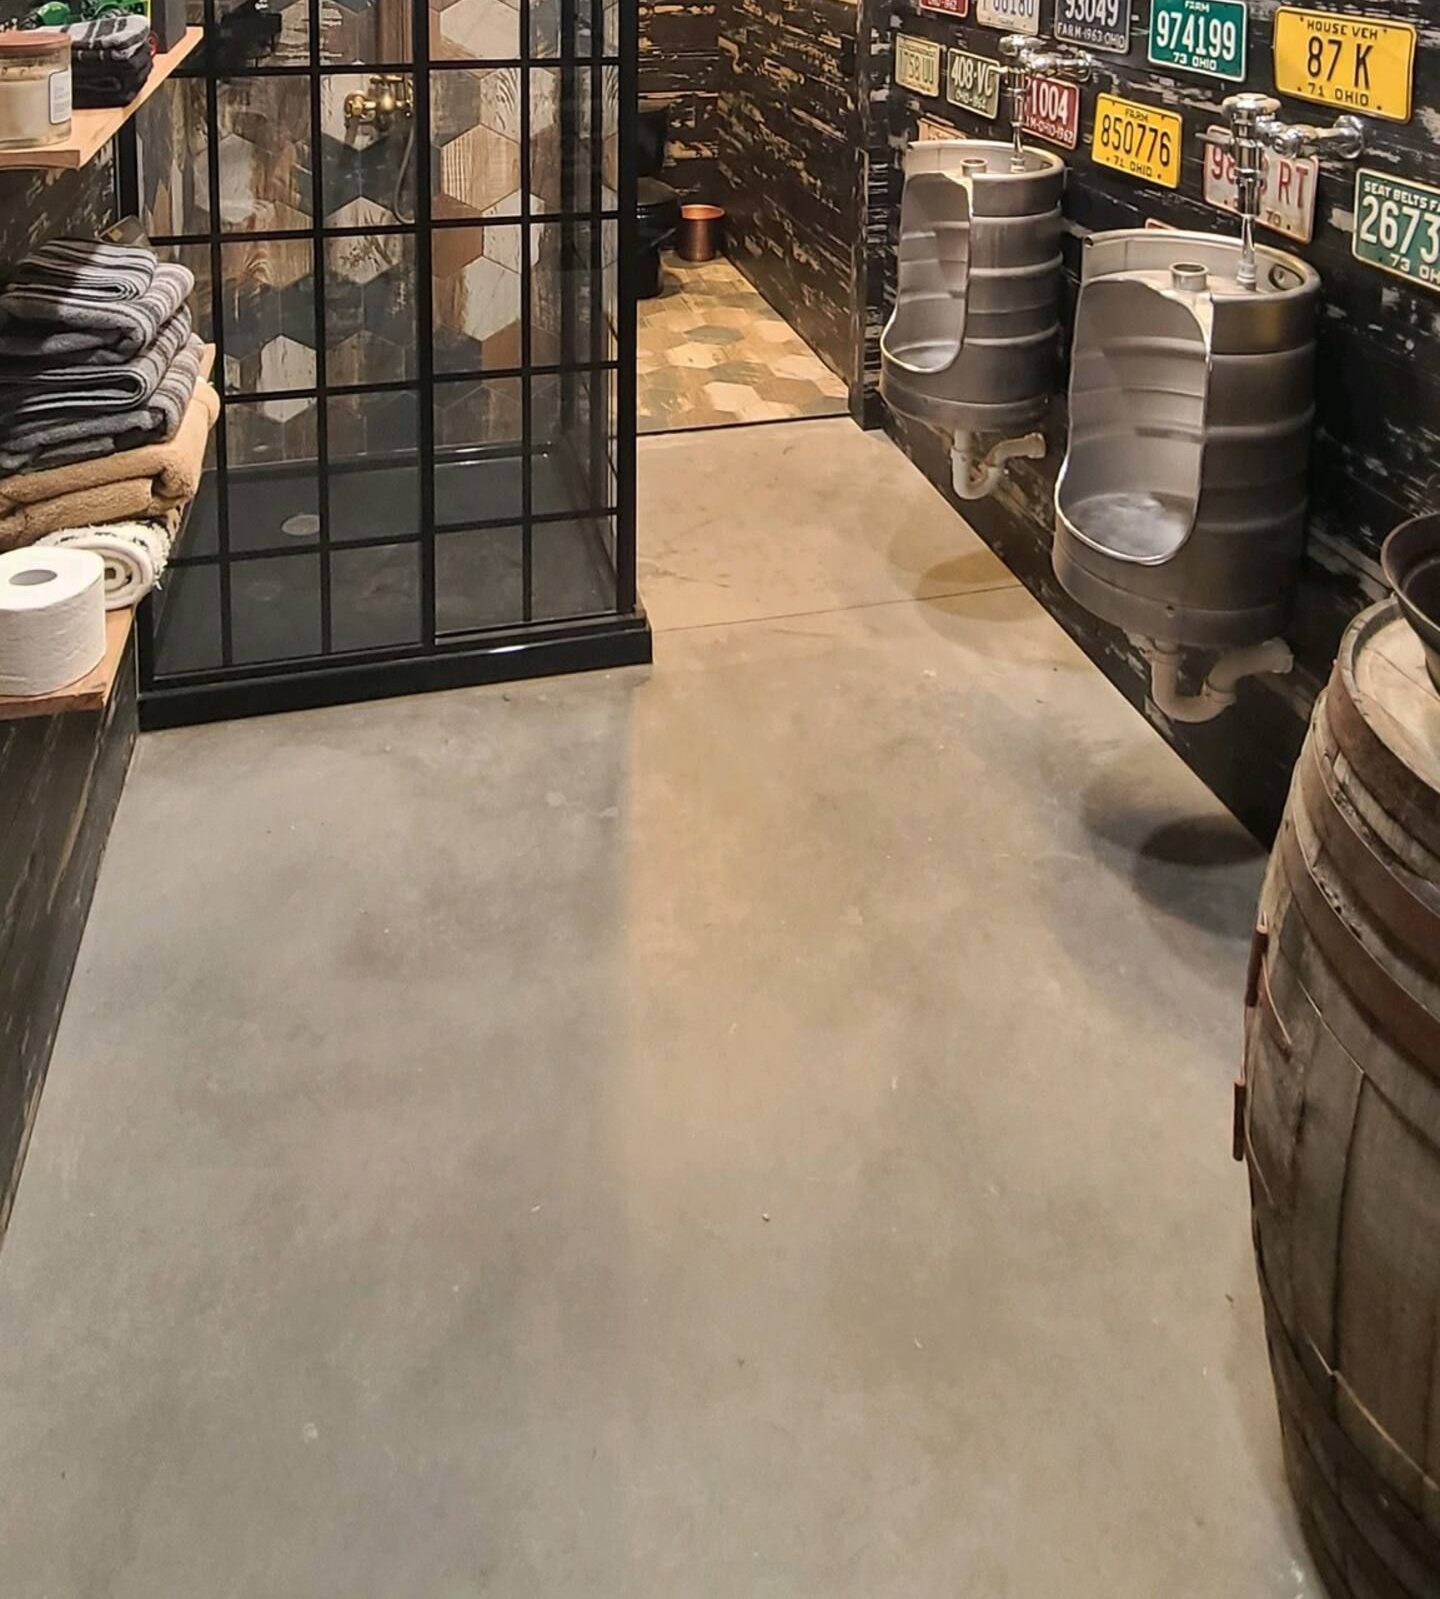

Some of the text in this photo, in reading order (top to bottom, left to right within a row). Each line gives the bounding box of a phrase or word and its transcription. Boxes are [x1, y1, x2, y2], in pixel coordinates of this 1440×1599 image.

[1185, 0, 1210, 13] FARM
[1157, 10, 1236, 61] 974199
[1307, 20, 1378, 40] HOUSE VEH
[1173, 52, 1217, 71] 73 OHIO
[1308, 36, 1373, 90] 87 K
[1308, 82, 1369, 106] 71 OHIO
[1125, 109, 1149, 122] FARM
[1100, 114, 1171, 167] 850776
[1131, 160, 1152, 176] OHIO
[1279, 161, 1308, 208] RT
[1364, 181, 1392, 197] SEAT
[1393, 190, 1428, 209] BELTS
[1266, 210, 1281, 225] 70
[1360, 195, 1440, 263] 2673
[1390, 254, 1410, 272] 73
